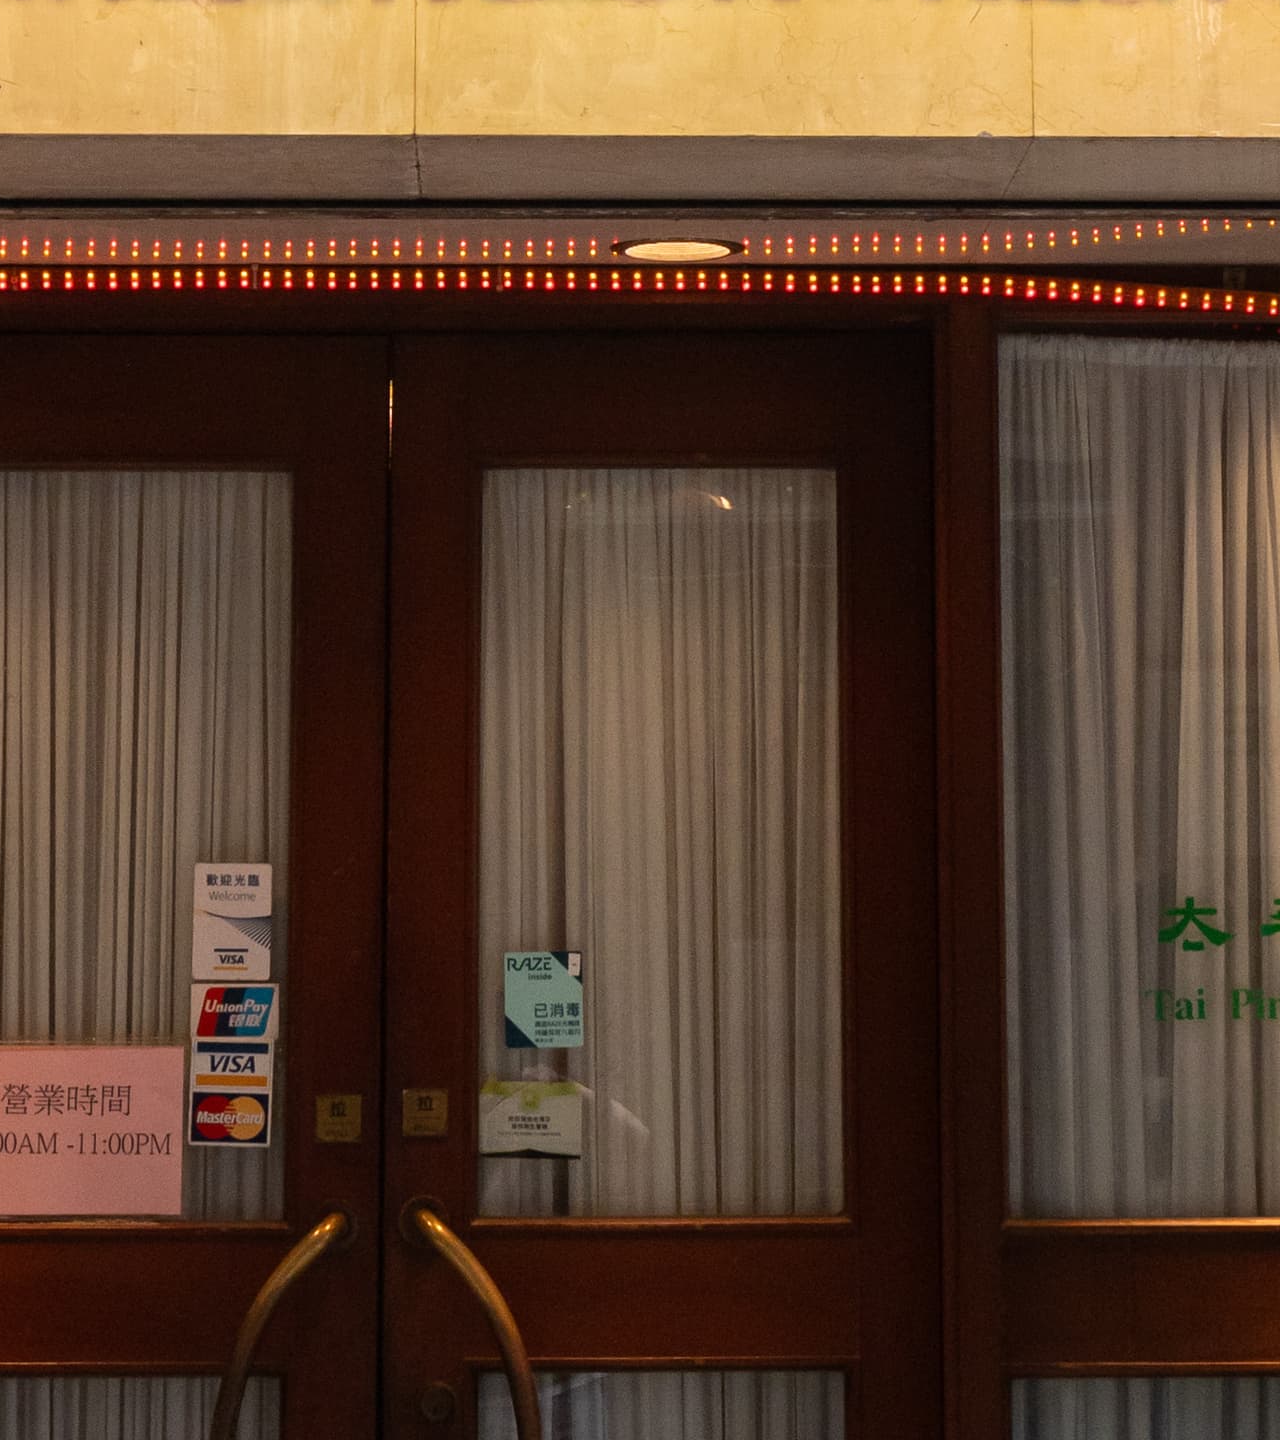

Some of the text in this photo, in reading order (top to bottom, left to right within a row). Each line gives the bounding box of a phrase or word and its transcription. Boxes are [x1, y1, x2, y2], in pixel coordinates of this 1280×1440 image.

[206, 873, 261, 887] 歡迎光臨
[208, 890, 257, 902] Welcome
[218, 954, 245, 965] VISA
[506, 957, 552, 972] RAZE
[528, 972, 553, 981] inside
[203, 998, 269, 1016] UnionPay
[533, 1002, 581, 1019] 已消毒
[1144, 987, 1207, 1022] Tai
[208, 1054, 256, 1074] VISA
[1, 1084, 133, 1117] 營業時間
[196, 1110, 264, 1125] MasterCard
